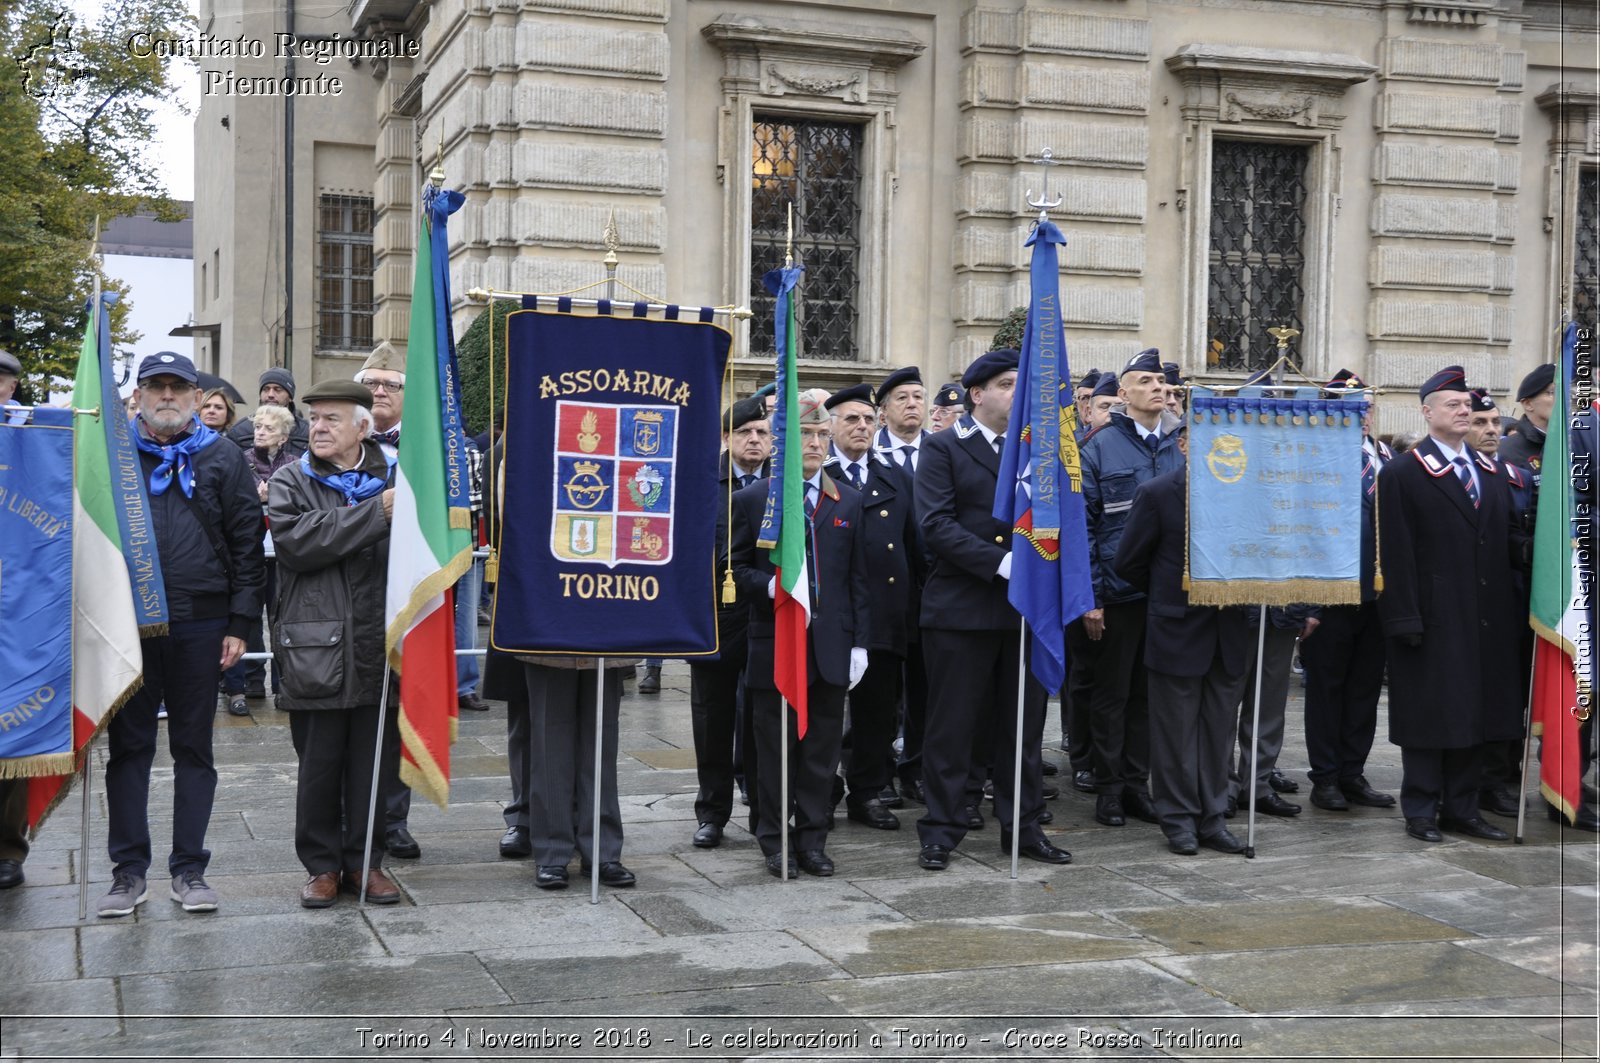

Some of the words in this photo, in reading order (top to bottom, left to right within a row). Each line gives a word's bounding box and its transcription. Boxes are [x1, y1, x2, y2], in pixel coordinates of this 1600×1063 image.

[1039, 294, 1054, 359] D'ITALIA
[445, 364, 455, 414] TORINO
[539, 368, 691, 407] ASSOARMA
[1039, 364, 1054, 427] MARINAI
[120, 449, 139, 491] CADUTI
[124, 492, 149, 548] FAMIGLIE
[559, 573, 660, 602] TORINO
